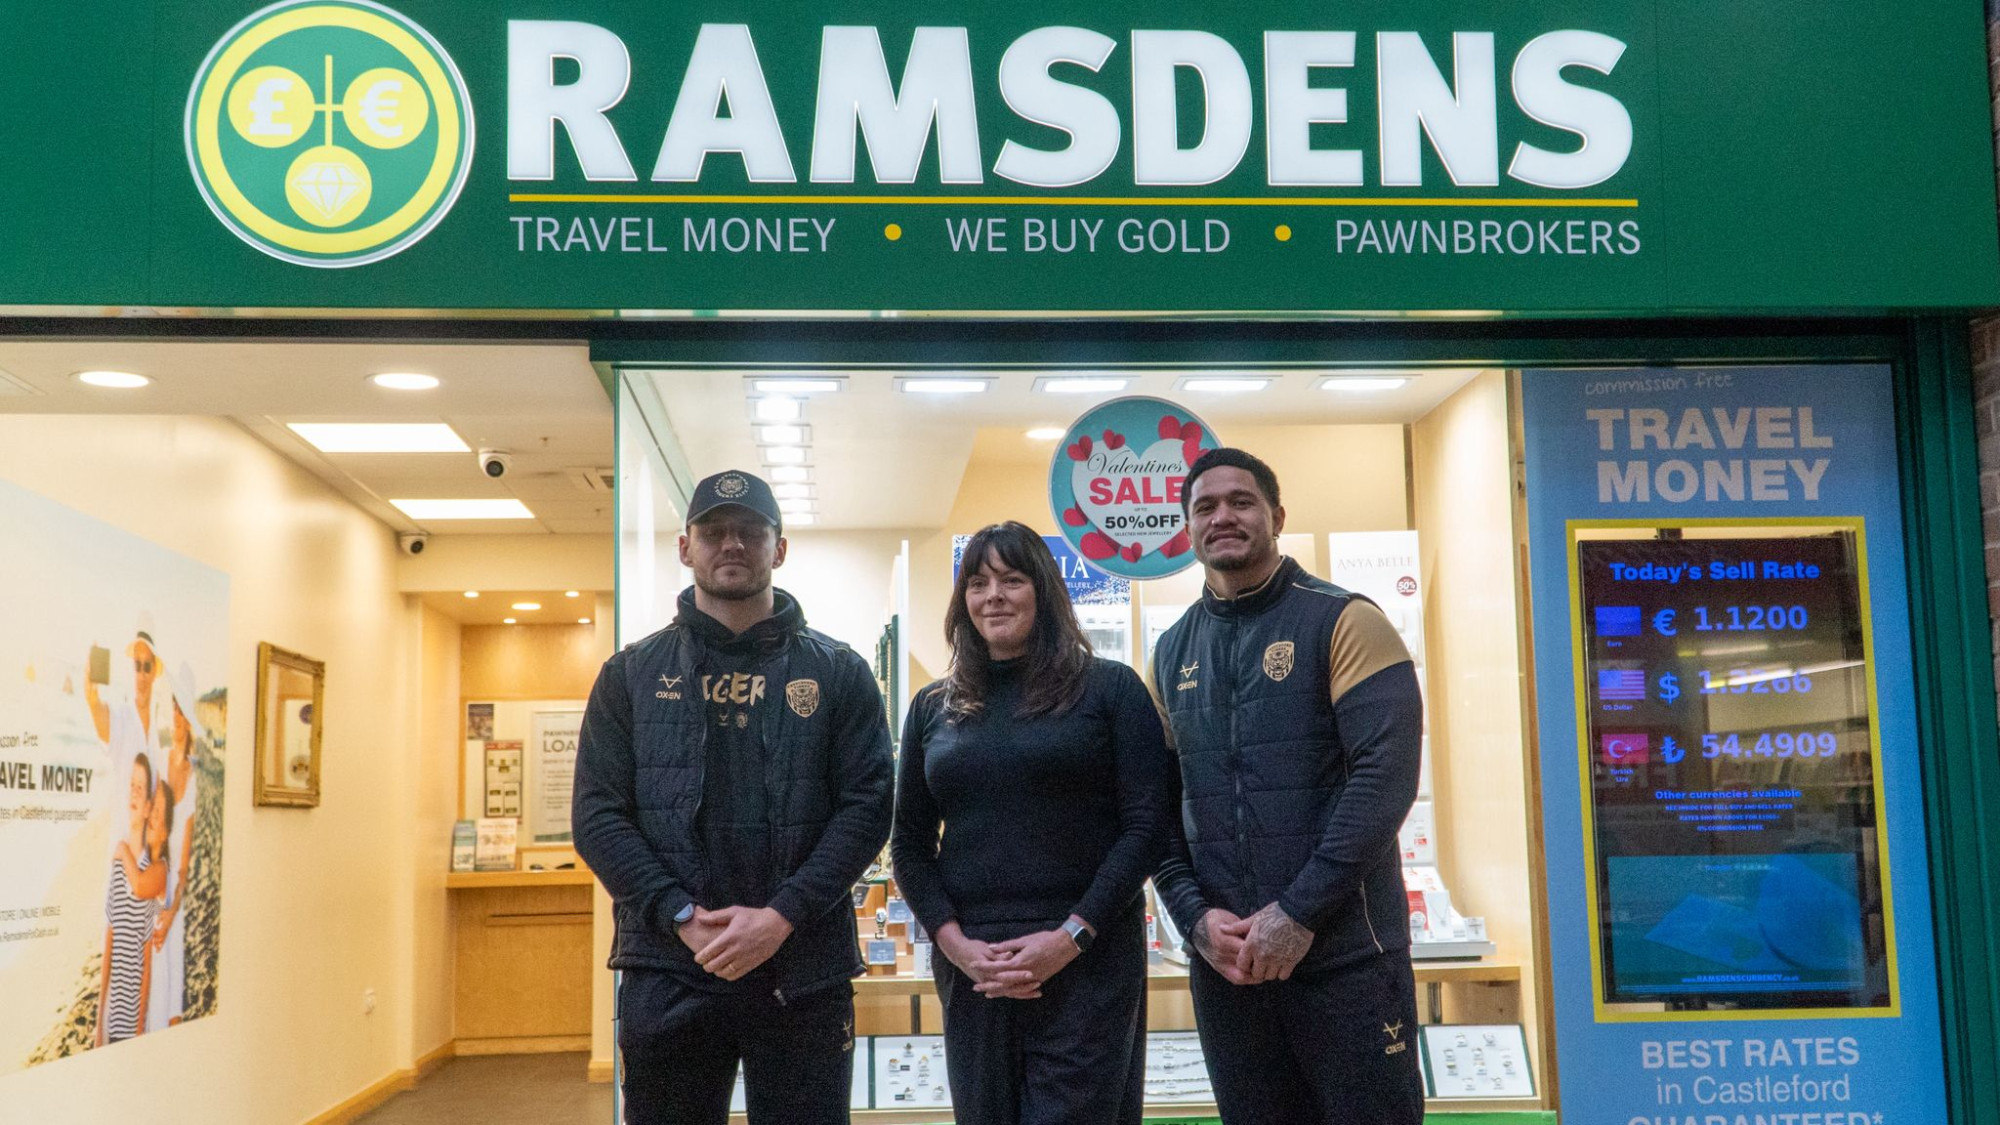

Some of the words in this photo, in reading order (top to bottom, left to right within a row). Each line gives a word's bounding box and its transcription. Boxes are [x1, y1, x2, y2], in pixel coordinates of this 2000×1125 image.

[507, 19, 1634, 189] RAMSDENS
[510, 216, 667, 253] TRAVEL
[683, 217, 837, 253] MONEY
[945, 217, 1008, 253] WE
[1024, 218, 1104, 254] BUY
[1117, 218, 1231, 254] GOLD
[1335, 219, 1641, 255] PAWNBROKERS
[1585, 374, 1687, 395] commission
[1693, 371, 1734, 389] free
[1586, 406, 1833, 451] TRAVEL
[1087, 449, 1182, 474] Valentines
[1089, 476, 1186, 506] SALE
[1597, 459, 1831, 502] MONEY
[1105, 515, 1181, 529] 50%OFF
[1609, 562, 1702, 584] Today's
[1709, 560, 1756, 580] Sell
[1762, 560, 1821, 579] Rate
[1694, 606, 1808, 631] 1.1200
[655, 691, 682, 700] OXEN
[1177, 680, 1198, 691] OXEN
[1702, 731, 1837, 758] 54.4909
[41, 765, 93, 793] MONEY
[1655, 790, 1685, 800] Other
[1689, 789, 1748, 799] currencies
[1751, 788, 1802, 798] available
[1641, 1040, 1732, 1069] BEST
[1743, 1037, 1860, 1067] RATES
[1657, 1079, 1682, 1104] in
[1693, 1074, 1850, 1103] Castleford
